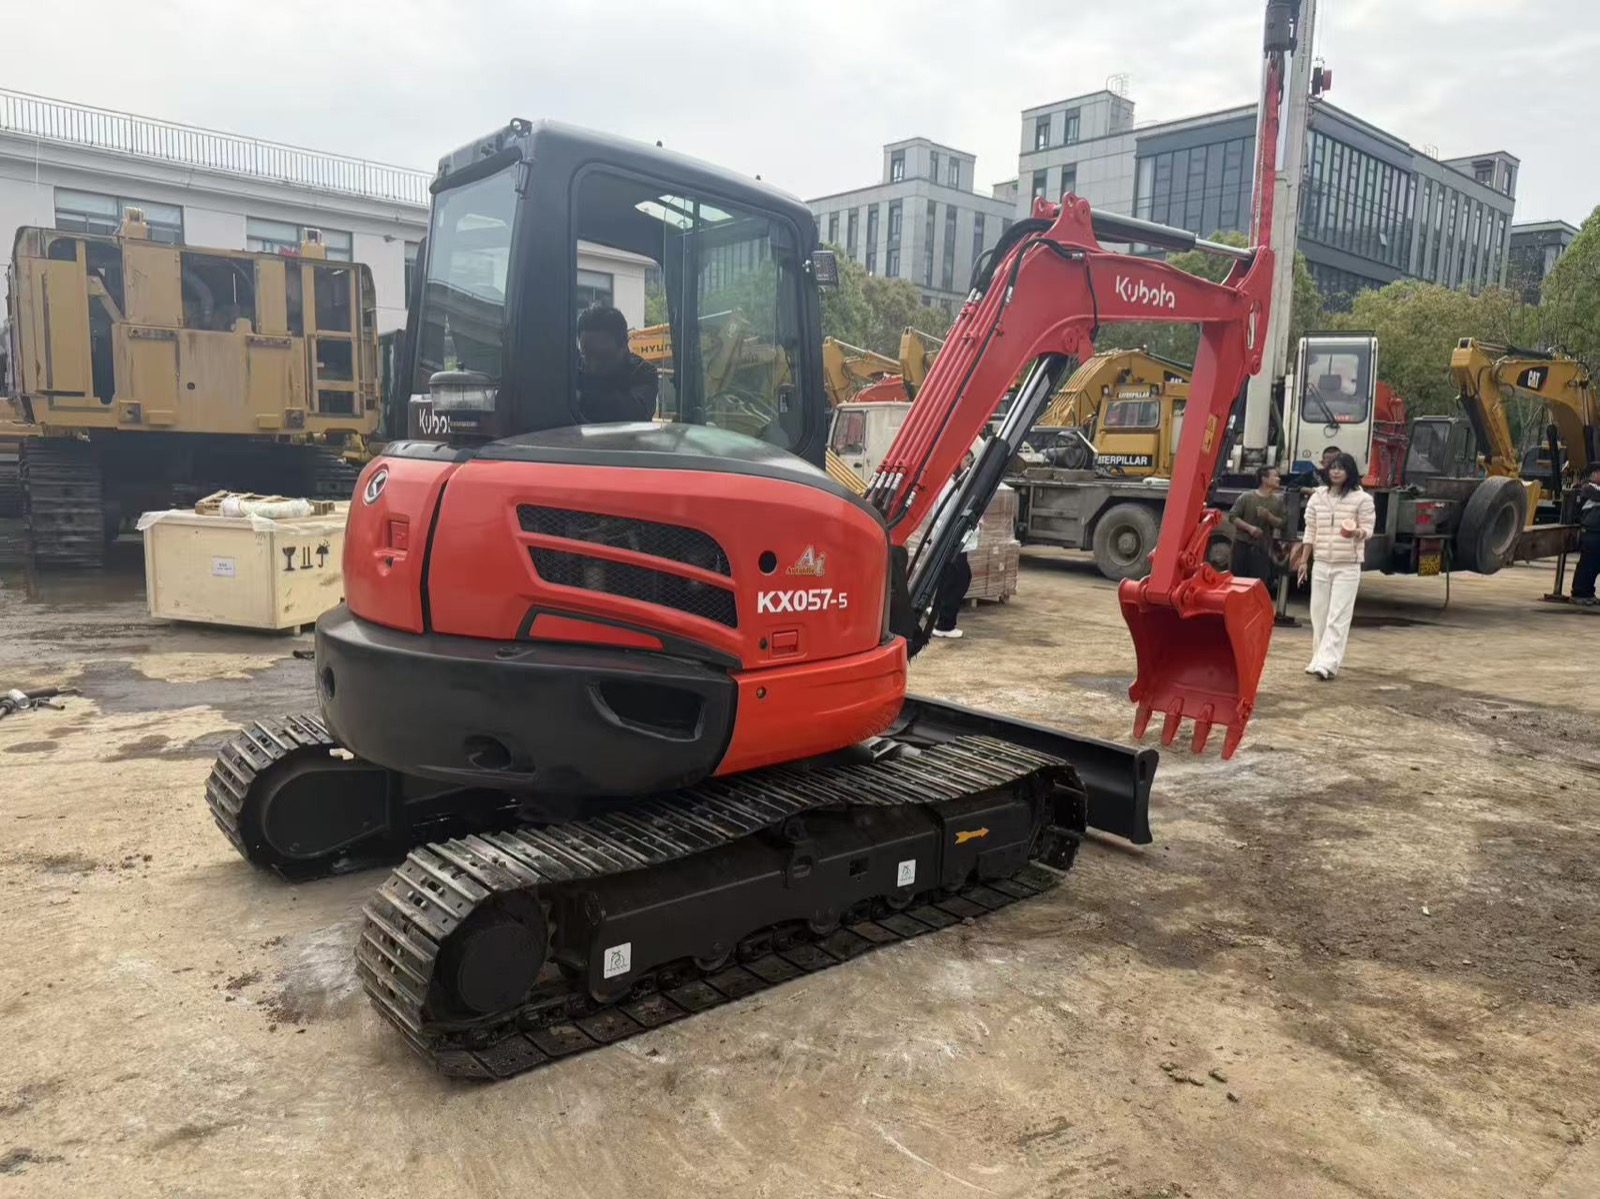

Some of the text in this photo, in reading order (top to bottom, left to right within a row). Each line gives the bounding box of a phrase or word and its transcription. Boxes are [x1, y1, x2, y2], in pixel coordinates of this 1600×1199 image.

[1115, 275, 1176, 309] Kubota
[1527, 370, 1541, 389] CAT
[1097, 455, 1148, 466] ATERPILLAR
[757, 588, 848, 613] KX057-5
